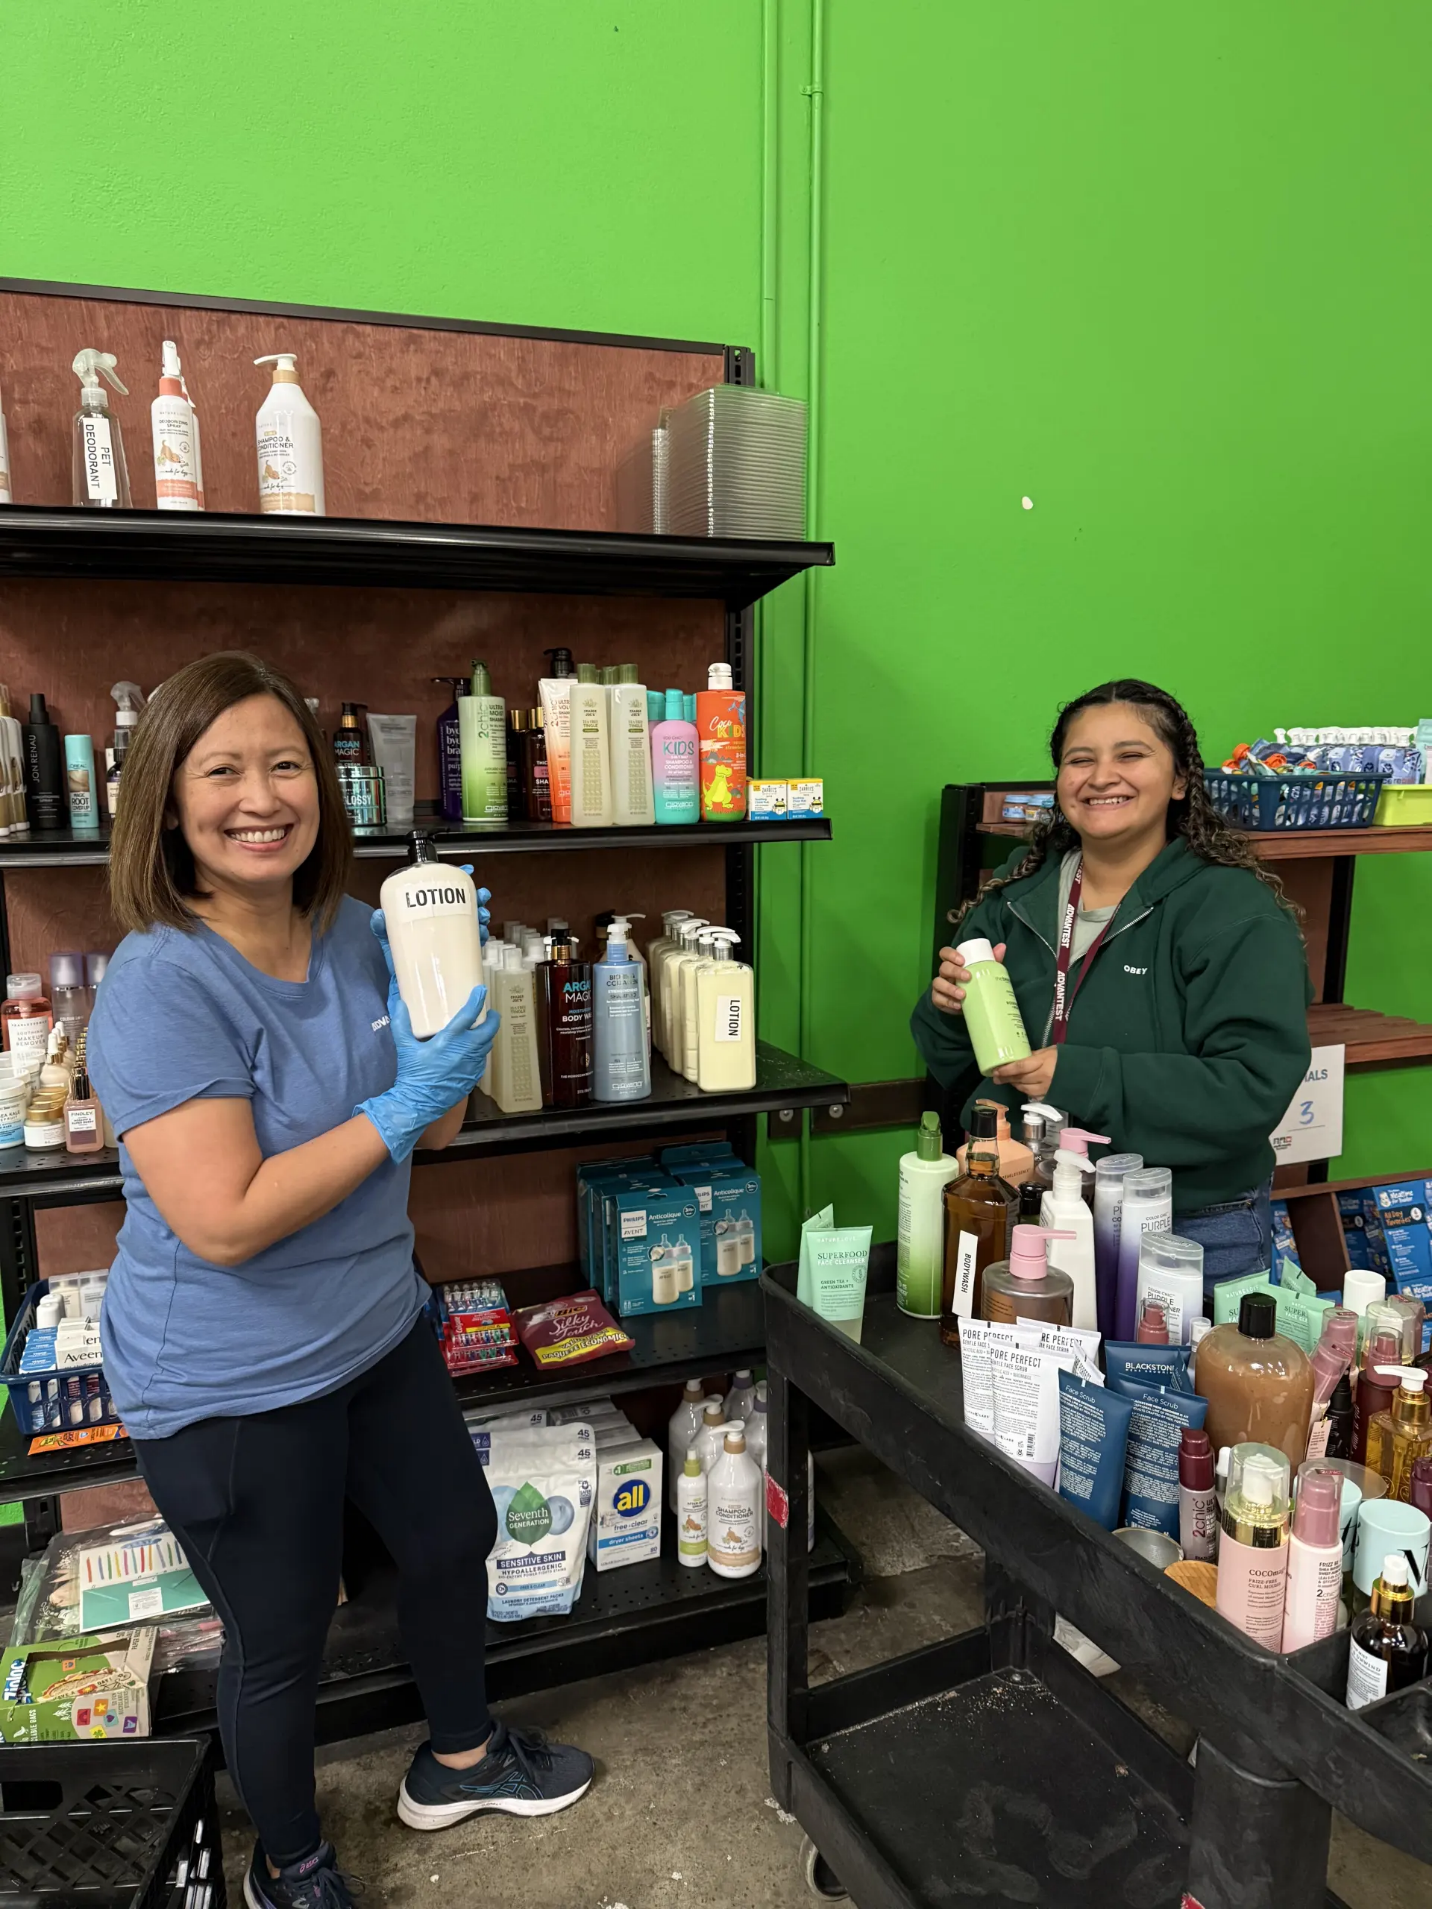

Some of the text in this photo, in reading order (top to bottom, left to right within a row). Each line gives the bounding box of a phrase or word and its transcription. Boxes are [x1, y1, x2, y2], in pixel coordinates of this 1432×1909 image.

[85, 424, 100, 488] DEODORANT
[100, 446, 111, 466] PET
[709, 716, 732, 732] Coco
[663, 740, 694, 756] KIDS
[28, 734, 40, 782] JON RENAU
[72, 798, 90, 806] ROOT
[405, 888, 467, 909] LOTION
[1061, 903, 1075, 948] ADVANTEST
[1123, 964, 1148, 975] OBEY
[1054, 970, 1066, 1021] ADVANTEST
[562, 1014, 582, 1022] BODY
[728, 1000, 741, 1036] LOTION
[18, 1034, 44, 1042] MAKEUP
[1299, 1101, 1314, 1125] 3
[714, 1188, 744, 1196] Anticolique
[648, 1212, 682, 1221] Anticolique
[1141, 1216, 1170, 1232] PURPLE
[818, 1250, 868, 1260] SUPERFOOD
[961, 1253, 971, 1293] BODYWASH
[550, 1314, 590, 1335] Silky
[553, 1322, 604, 1342] Touch
[962, 1329, 981, 1340] PORE
[990, 1348, 1041, 1368] PORE PERFECT
[1014, 1364, 1028, 1373] SCRUB
[1065, 1385, 1096, 1404] Face Scrub
[1143, 1393, 1179, 1410] Face Scrub
[530, 1414, 542, 1422] 45
[578, 1429, 590, 1437] 45
[578, 1449, 591, 1457] 45
[616, 1484, 644, 1512] all
[508, 1508, 549, 1522] Seventh
[716, 1510, 753, 1519] CONDITIONER
[717, 1506, 746, 1514] SHAMPOO
[509, 1518, 550, 1529] GENERATION
[631, 1520, 648, 1528] clear
[1192, 1500, 1206, 1538] 2chic
[608, 1534, 644, 1546] dryer sheets
[500, 1553, 562, 1568] SENSITIVE SKIN
[502, 1562, 562, 1575] HYPOALLERGENIC
[29, 1709, 37, 1723] BAGS
